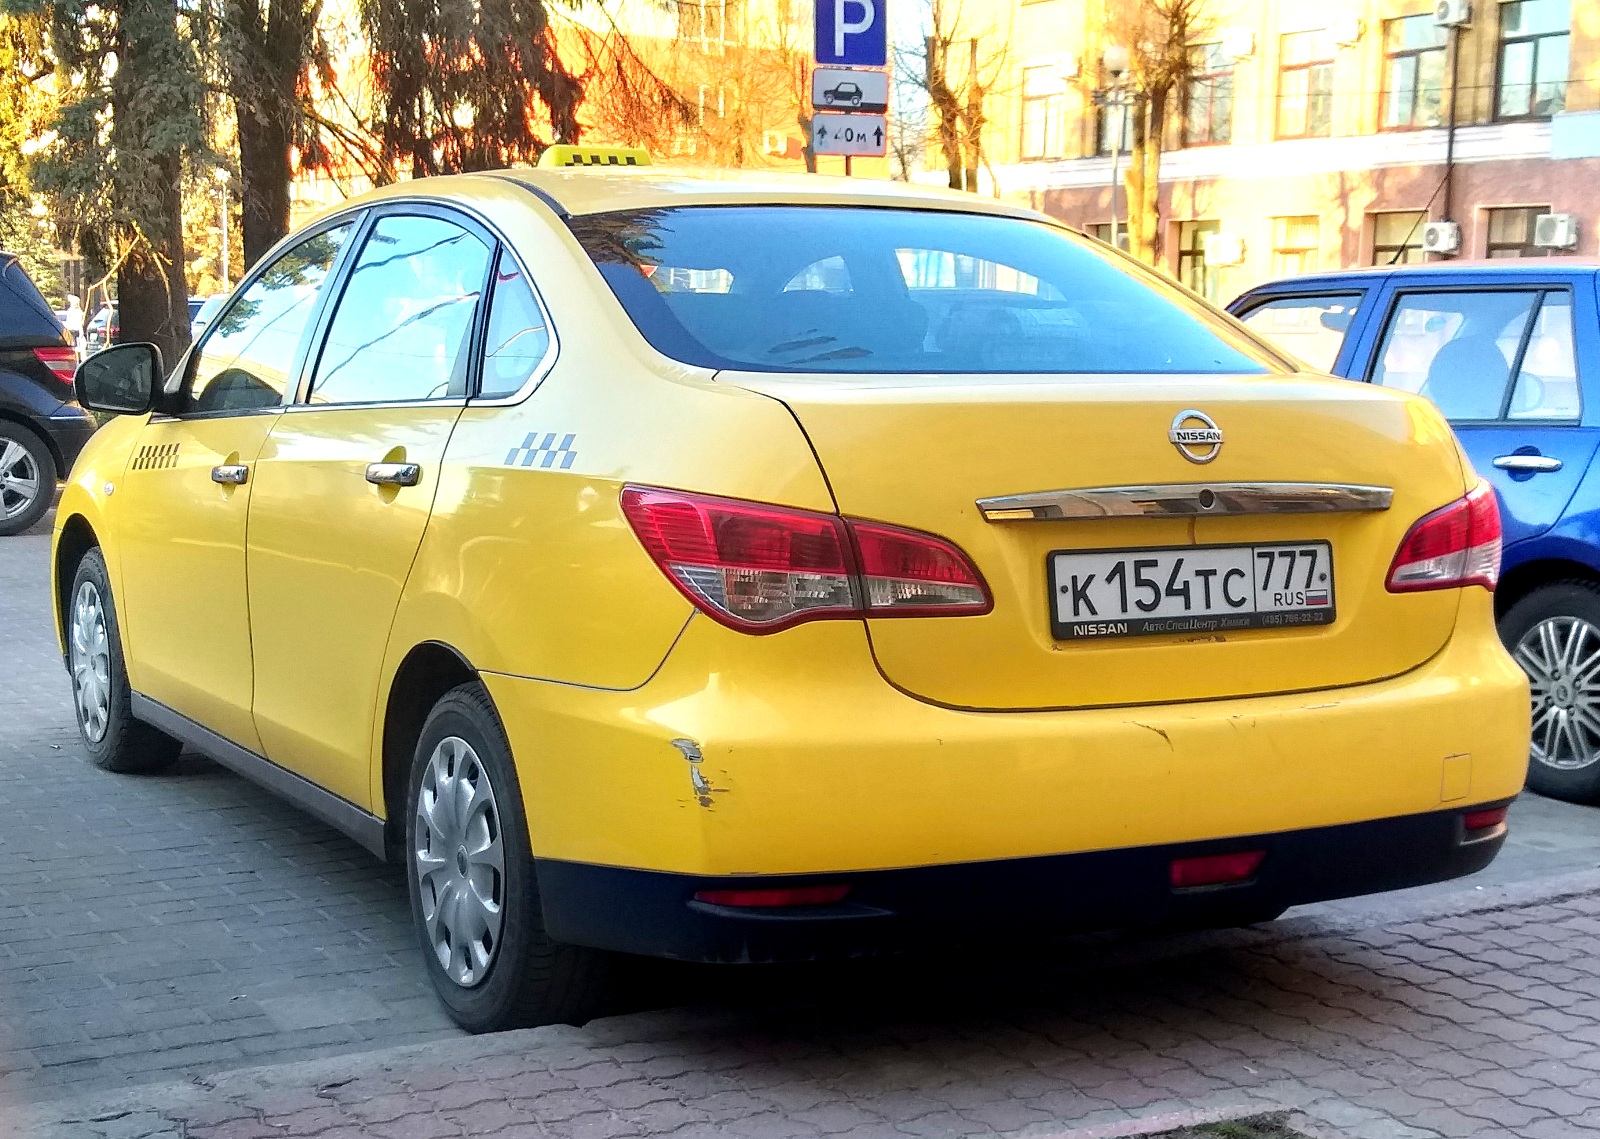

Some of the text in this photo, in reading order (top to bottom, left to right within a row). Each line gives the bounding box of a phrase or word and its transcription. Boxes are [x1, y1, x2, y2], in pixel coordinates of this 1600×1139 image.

[834, 0, 875, 57] P
[1176, 432, 1221, 441] NISSAN
[1257, 549, 1318, 591] 777
[1273, 591, 1305, 606] RUS
[1073, 622, 1128, 636] NISSAN
